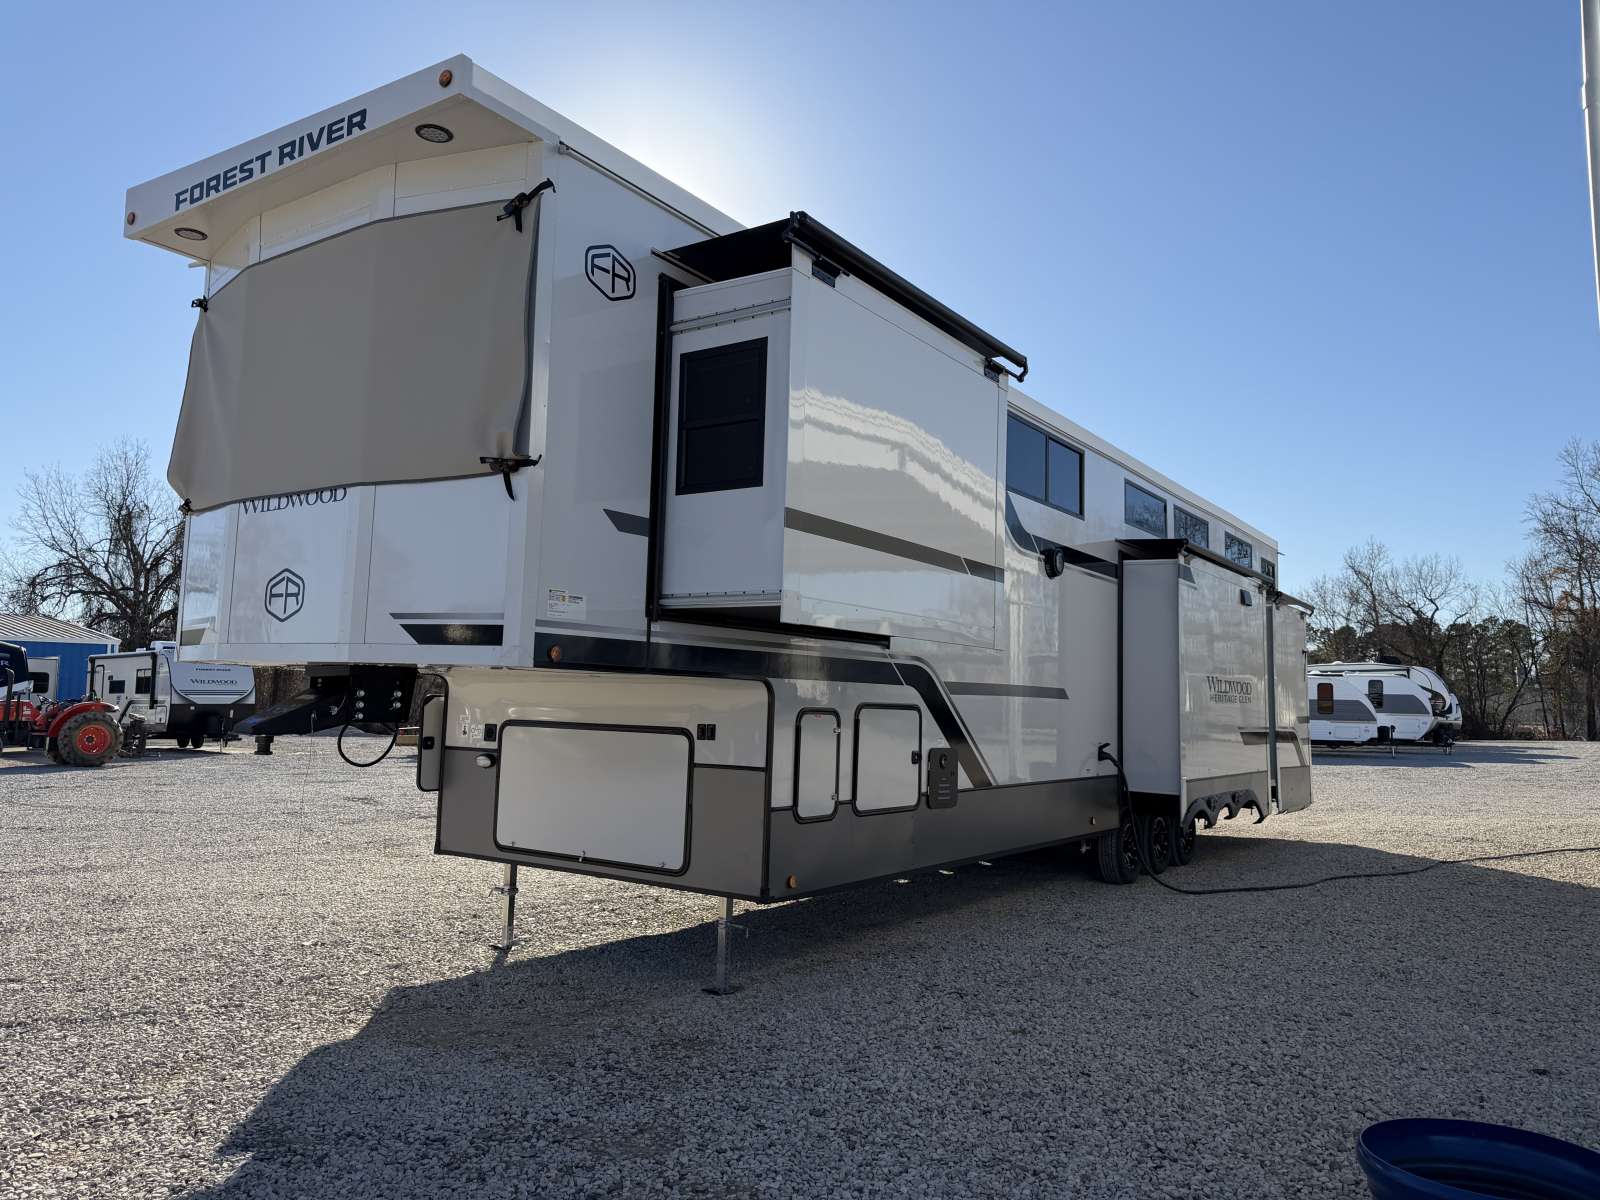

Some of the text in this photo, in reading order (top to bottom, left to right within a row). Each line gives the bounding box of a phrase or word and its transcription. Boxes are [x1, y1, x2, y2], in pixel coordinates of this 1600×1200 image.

[174, 108, 367, 212] FOREST RIVER
[242, 487, 348, 515] WILDWOOD
[190, 678, 238, 686] WILDWOOD
[1206, 675, 1253, 696] WILDWOOD
